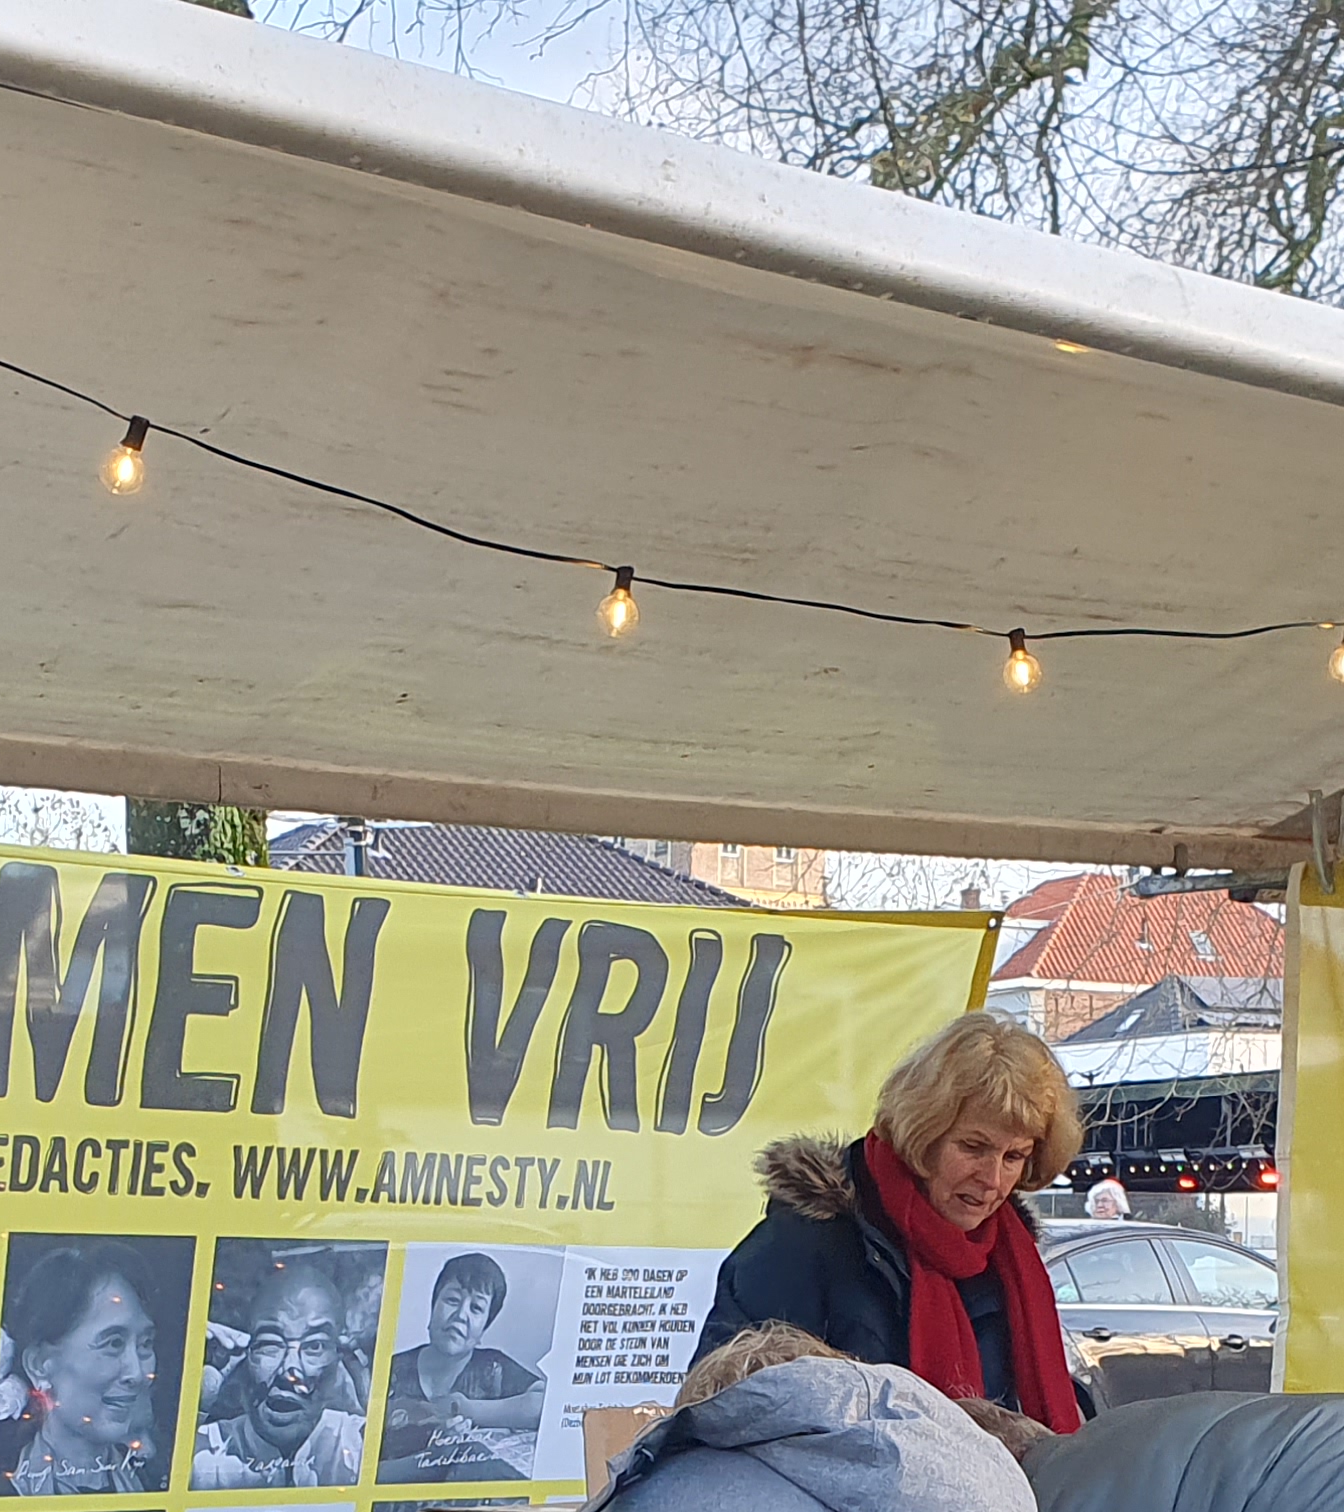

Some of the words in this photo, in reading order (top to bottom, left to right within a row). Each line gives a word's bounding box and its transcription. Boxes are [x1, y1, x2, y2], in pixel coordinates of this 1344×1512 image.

[466, 905, 792, 1135] VRIJ
[232, 1144, 615, 1213] WWW.AMNESTY.NL
[600, 1268, 618, 1281] HEB
[643, 1269, 674, 1282] DAGEN
[676, 1269, 688, 1282] OP
[585, 1285, 603, 1299] EEN
[670, 1303, 687, 1316] HEB
[580, 1320, 598, 1334] HET
[603, 1320, 618, 1334] VOL
[658, 1320, 695, 1333] HOUDEN
[578, 1338, 602, 1351] DOOR
[606, 1338, 616, 1351] DE
[620, 1337, 647, 1351] STEUN
[651, 1337, 670, 1350] VAN
[575, 1355, 611, 1368] MENSEN
[614, 1355, 628, 1367] DIE
[631, 1355, 652, 1367] ZICH
[655, 1354, 670, 1367] OM
[572, 1372, 592, 1385] MIJN
[595, 1372, 611, 1385] LOT
